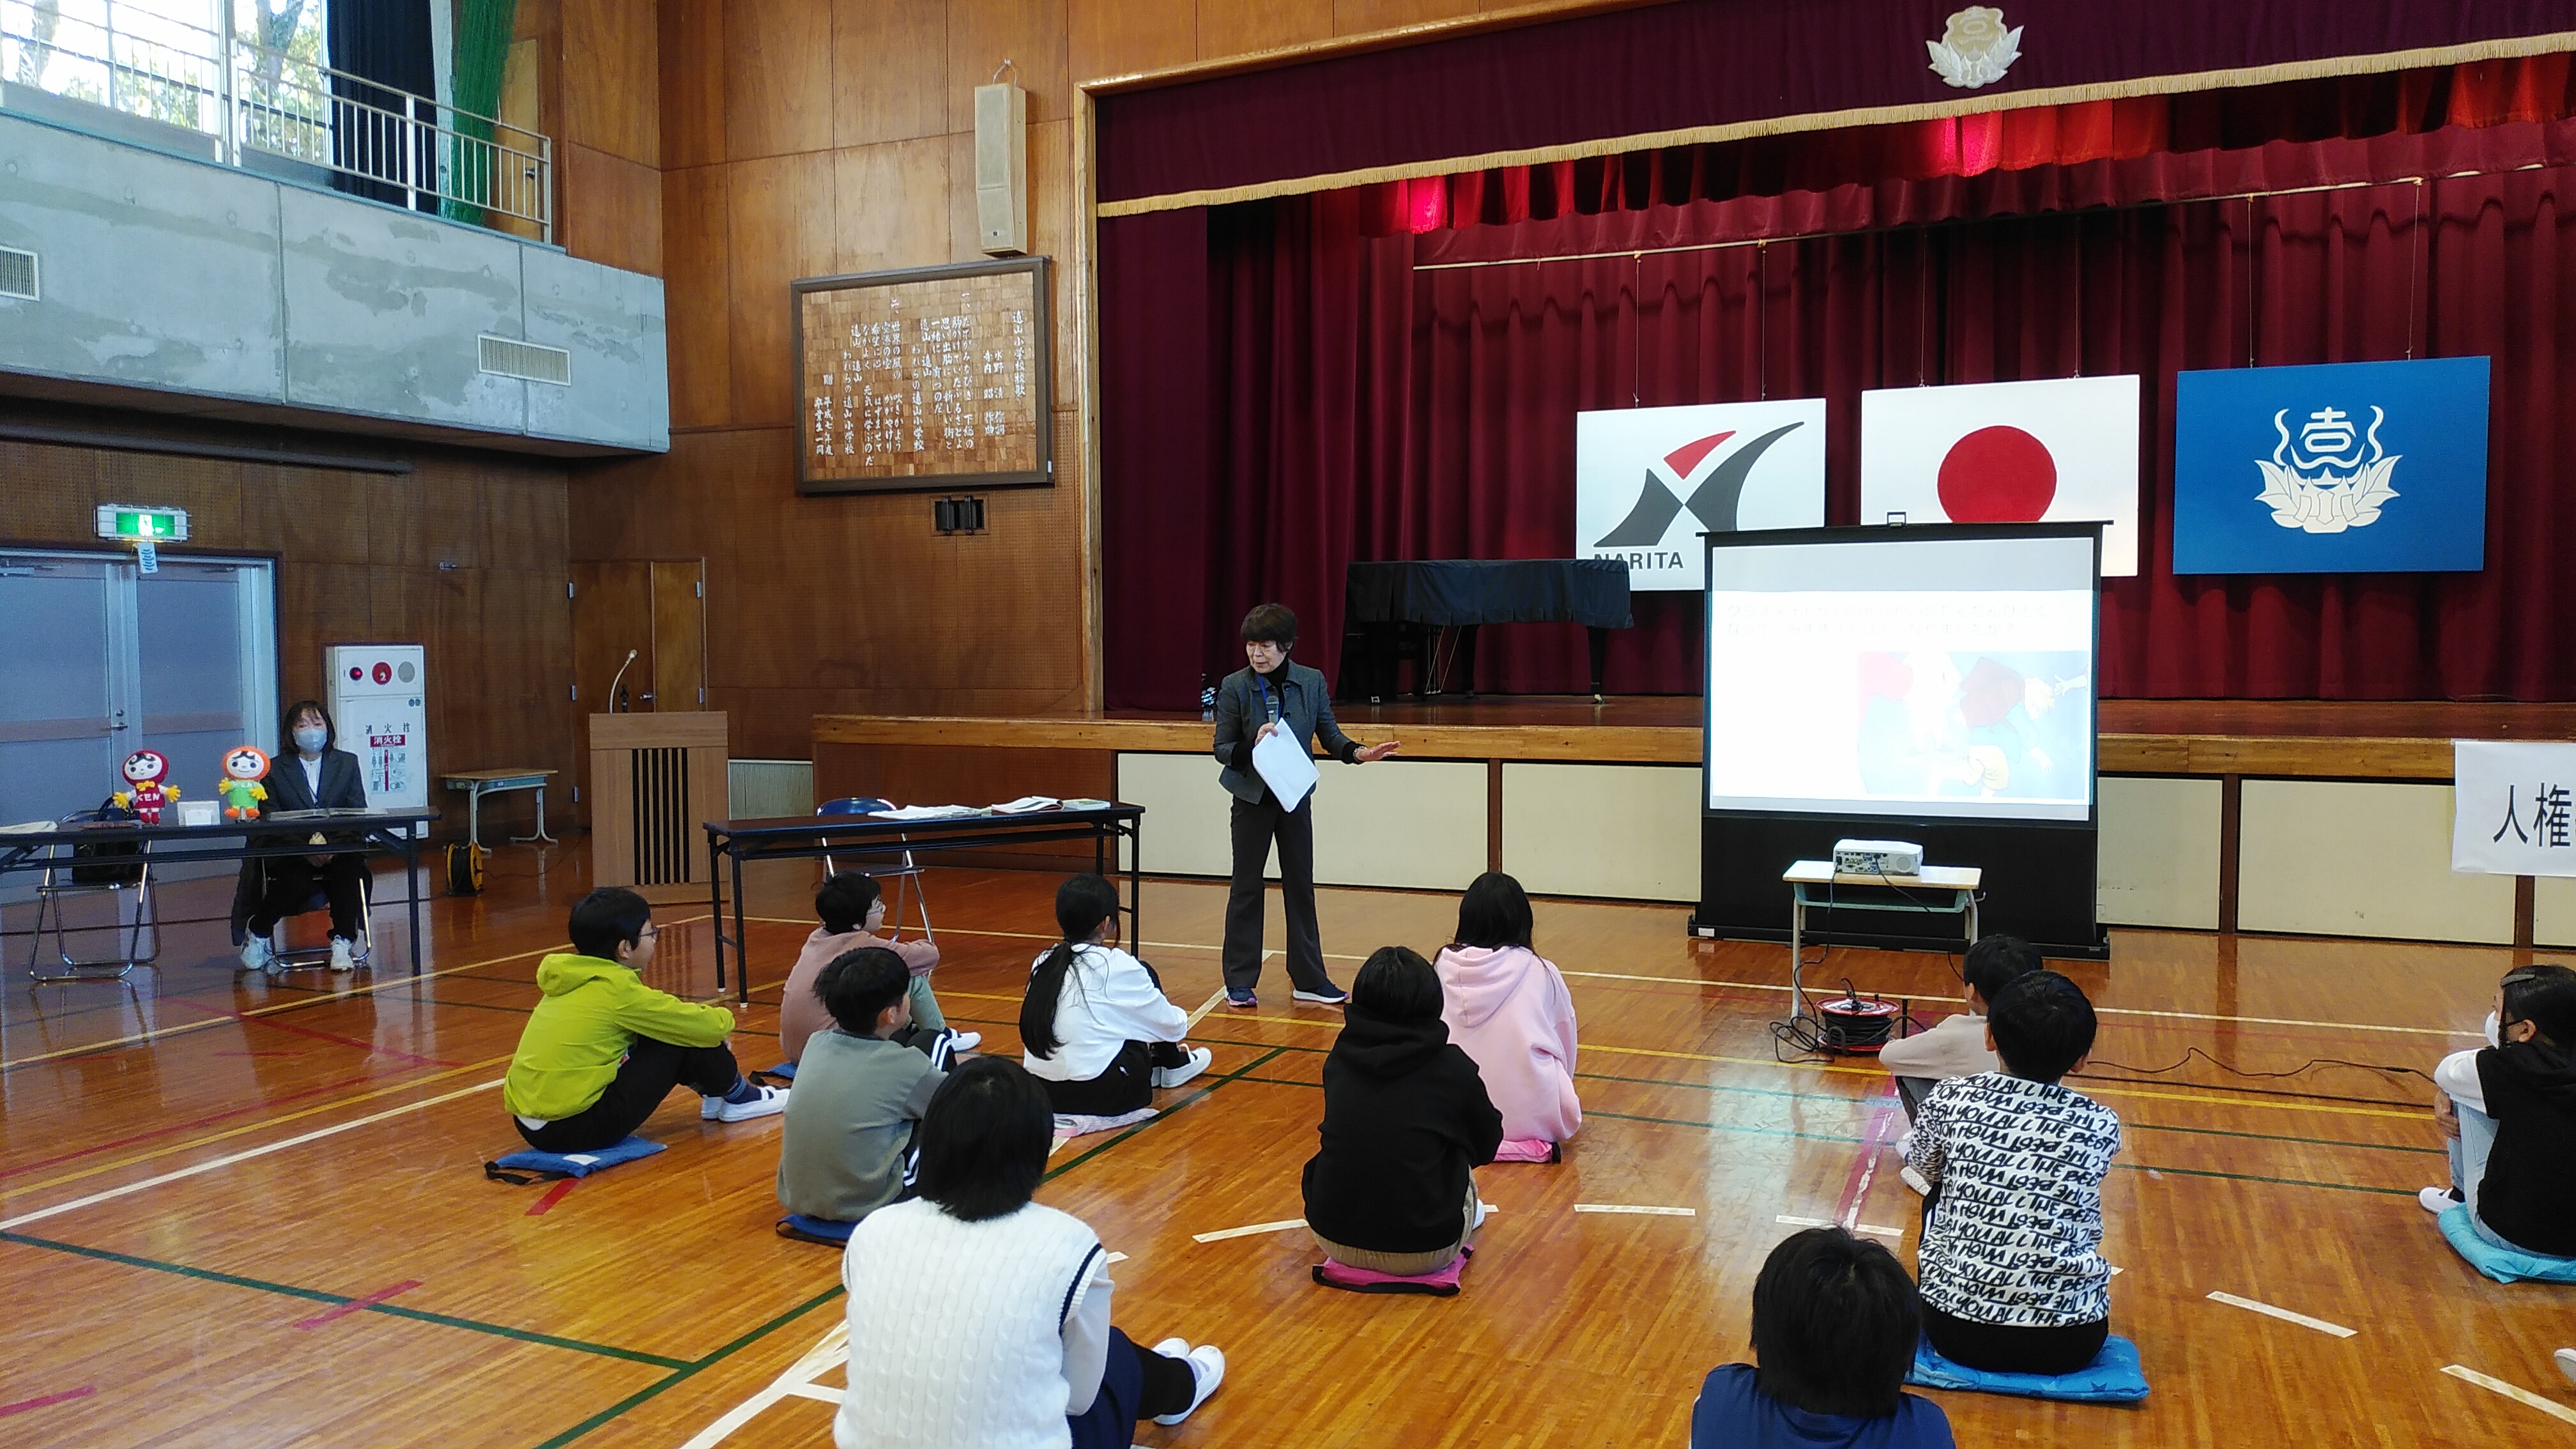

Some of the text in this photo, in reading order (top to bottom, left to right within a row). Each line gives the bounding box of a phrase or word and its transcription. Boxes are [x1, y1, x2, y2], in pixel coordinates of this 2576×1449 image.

[993, 349, 1004, 374] 水野
[1013, 310, 1025, 397] 遠山小学校校歌
[985, 411, 994, 434] 作曲
[995, 411, 1005, 435] 作詞
[136, 793, 160, 802] KEN
[2492, 782, 2576, 848] 人権
